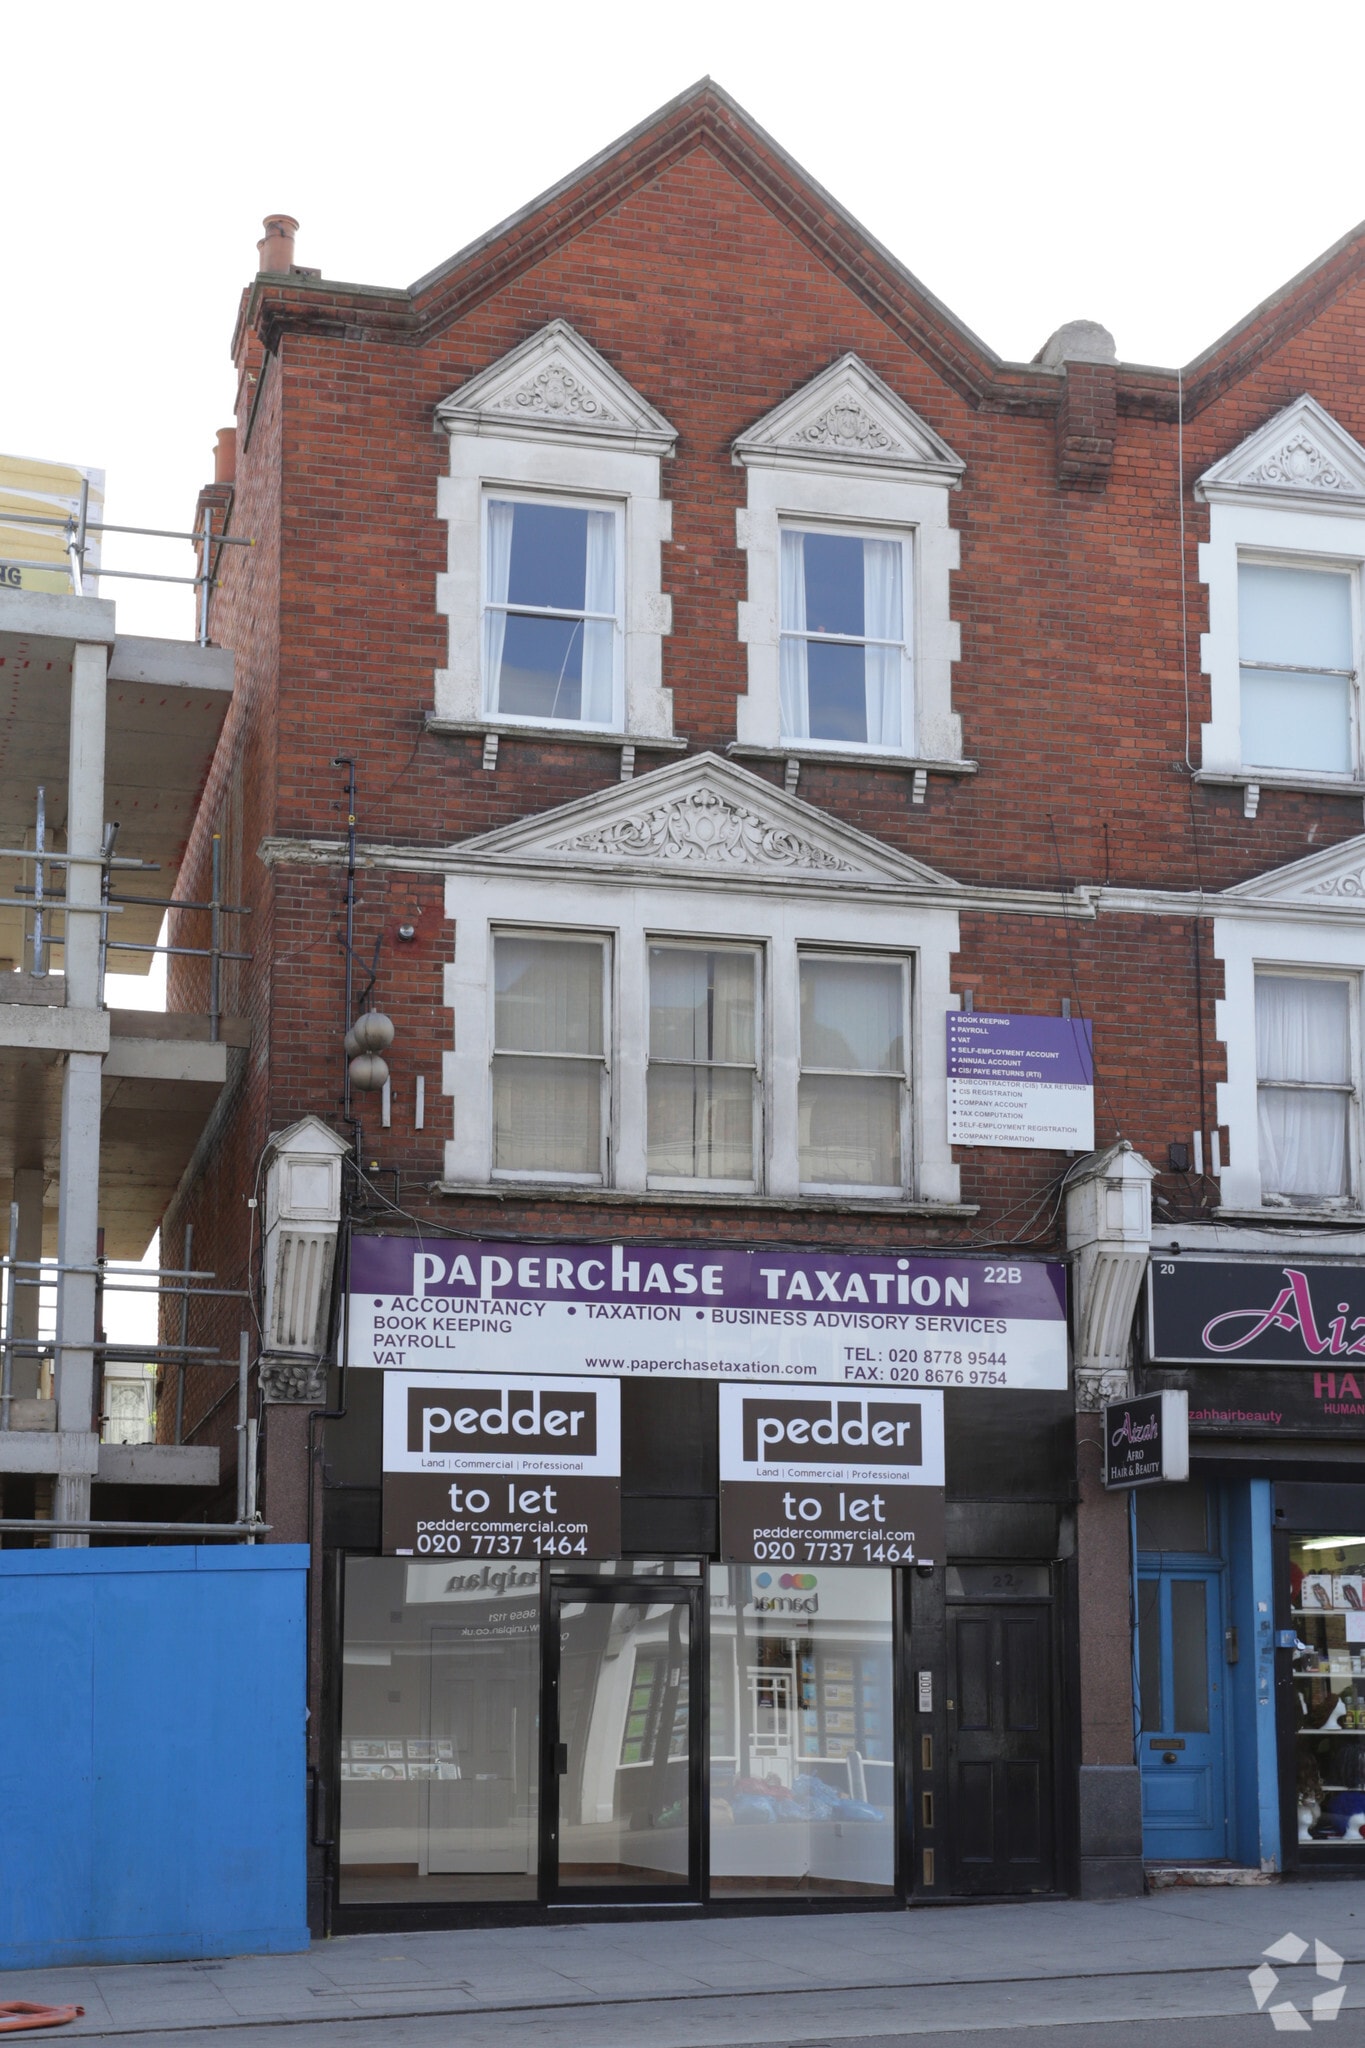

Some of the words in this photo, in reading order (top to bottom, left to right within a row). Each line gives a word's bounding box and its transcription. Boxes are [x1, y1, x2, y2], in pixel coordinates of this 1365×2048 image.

[958, 1047, 1024, 1056] SELF-EMPLOYMENT
[1026, 1051, 1059, 1059] ACCOUNT
[992, 1069, 1024, 1077] RETURNS
[1025, 1071, 1042, 1079] (RTI)
[958, 1079, 1020, 1088] SUBCONTRACTOR
[1022, 1082, 1038, 1090] (CIS)
[972, 1089, 1023, 1098] REGISTRATION
[959, 1099, 992, 1107] COMPANY
[995, 1101, 1028, 1109] ACCOUNT
[974, 1111, 1023, 1119] COMPUTATION
[958, 1121, 1026, 1131] SELF-EMPLOYMENT
[1027, 1125, 1078, 1133] REGISTRATION
[959, 1132, 992, 1140] COMPANY
[995, 1134, 1035, 1142] FORMATION
[984, 1266, 1022, 1284] 22B
[1160, 1264, 1175, 1275] 20
[390, 1297, 546, 1317] ACCOUNTANCY
[585, 1304, 681, 1321] TAXATION
[711, 1309, 808, 1326] BUSINESS
[813, 1313, 910, 1331] ADVISORY
[915, 1316, 1007, 1334] SERVICES
[374, 1316, 427, 1330] BOOK
[433, 1318, 512, 1334] KEEPING
[374, 1334, 456, 1348] PAYROLL
[373, 1352, 406, 1365] VAT
[844, 1348, 883, 1362] TEL:
[888, 1349, 918, 1364] 020
[923, 1351, 962, 1365] 8778
[968, 1351, 1007, 1366] 9544
[585, 1356, 817, 1375] www.paperchasetaxation.com
[844, 1366, 884, 1380] FAX:
[889, 1368, 919, 1382] 020
[924, 1369, 964, 1384] 8676
[969, 1371, 1007, 1385] 9754
[1313, 1372, 1365, 1399] HA
[1324, 1403, 1365, 1415] HUMAN
[422, 1389, 585, 1452] pedder
[1188, 1409, 1282, 1424] zahhairbeauty
[757, 1400, 911, 1462] pedder
[1112, 1412, 1158, 1447] Aizah
[421, 1459, 445, 1468] Land
[454, 1459, 513, 1469] Commercial
[522, 1461, 583, 1470] Professional
[1128, 1465, 1134, 1476] &
[756, 1468, 779, 1476] Land
[788, 1468, 843, 1478] Commercial
[852, 1470, 910, 1480] Professional
[448, 1483, 490, 1513] to
[508, 1484, 558, 1514] let
[782, 1491, 822, 1521] to
[839, 1492, 886, 1522] let
[416, 1519, 588, 1533] peddercommercial.com
[753, 1527, 915, 1541] peddercommercial.com
[417, 1534, 461, 1553] 020
[471, 1536, 523, 1554] 7737
[532, 1536, 588, 1555] 1464
[753, 1541, 795, 1560] 020
[804, 1543, 854, 1561] 7737
[862, 1543, 914, 1563] 1464
